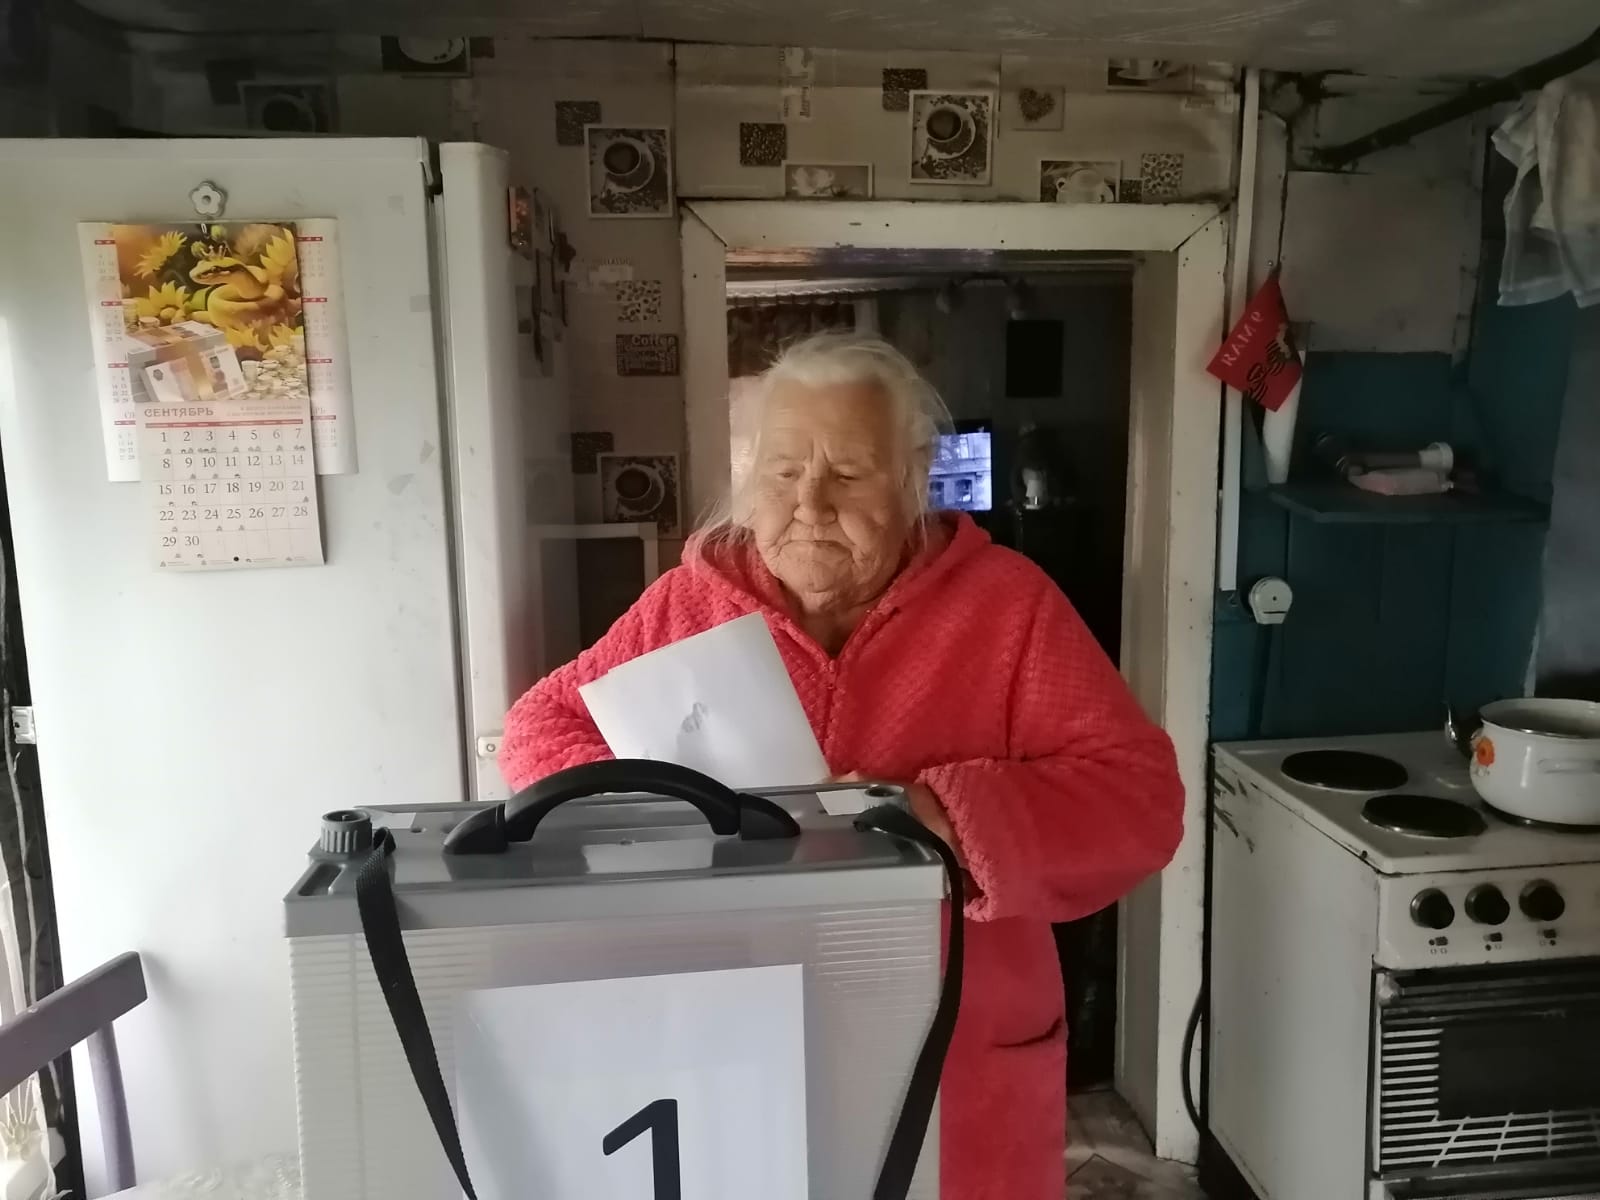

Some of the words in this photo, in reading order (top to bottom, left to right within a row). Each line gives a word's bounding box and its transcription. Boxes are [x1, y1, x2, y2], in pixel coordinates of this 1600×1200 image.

[632, 334, 675, 345] Coffee
[144, 407, 214, 418] СЕНТЯБРЬ
[161, 432, 167, 442] 1
[183, 432, 191, 441] 2
[206, 431, 213, 441] 3
[229, 431, 236, 440] 4
[251, 431, 258, 440] 5
[273, 430, 280, 439] 6
[295, 428, 302, 438] 7
[162, 459, 170, 468] 8
[186, 458, 192, 468] 9
[202, 458, 216, 468] 10
[226, 457, 237, 467] 11
[248, 456, 260, 466] 12
[270, 456, 282, 465] 13
[292, 455, 304, 464] 14
[160, 485, 172, 495] 15
[183, 485, 195, 494] 16
[204, 484, 216, 493] 17
[227, 483, 239, 492] 18
[248, 482, 261, 492] 19
[269, 481, 284, 491] 20
[292, 481, 304, 490] 21
[160, 511, 174, 520] 22
[182, 510, 197, 520] 23
[204, 510, 219, 519] 24
[227, 509, 241, 518] 25
[249, 508, 264, 518] 26
[272, 508, 285, 517] 27
[293, 507, 308, 516] 28
[162, 537, 177, 547] 29
[185, 536, 199, 546] 30
[602, 1098, 681, 1200] 1
